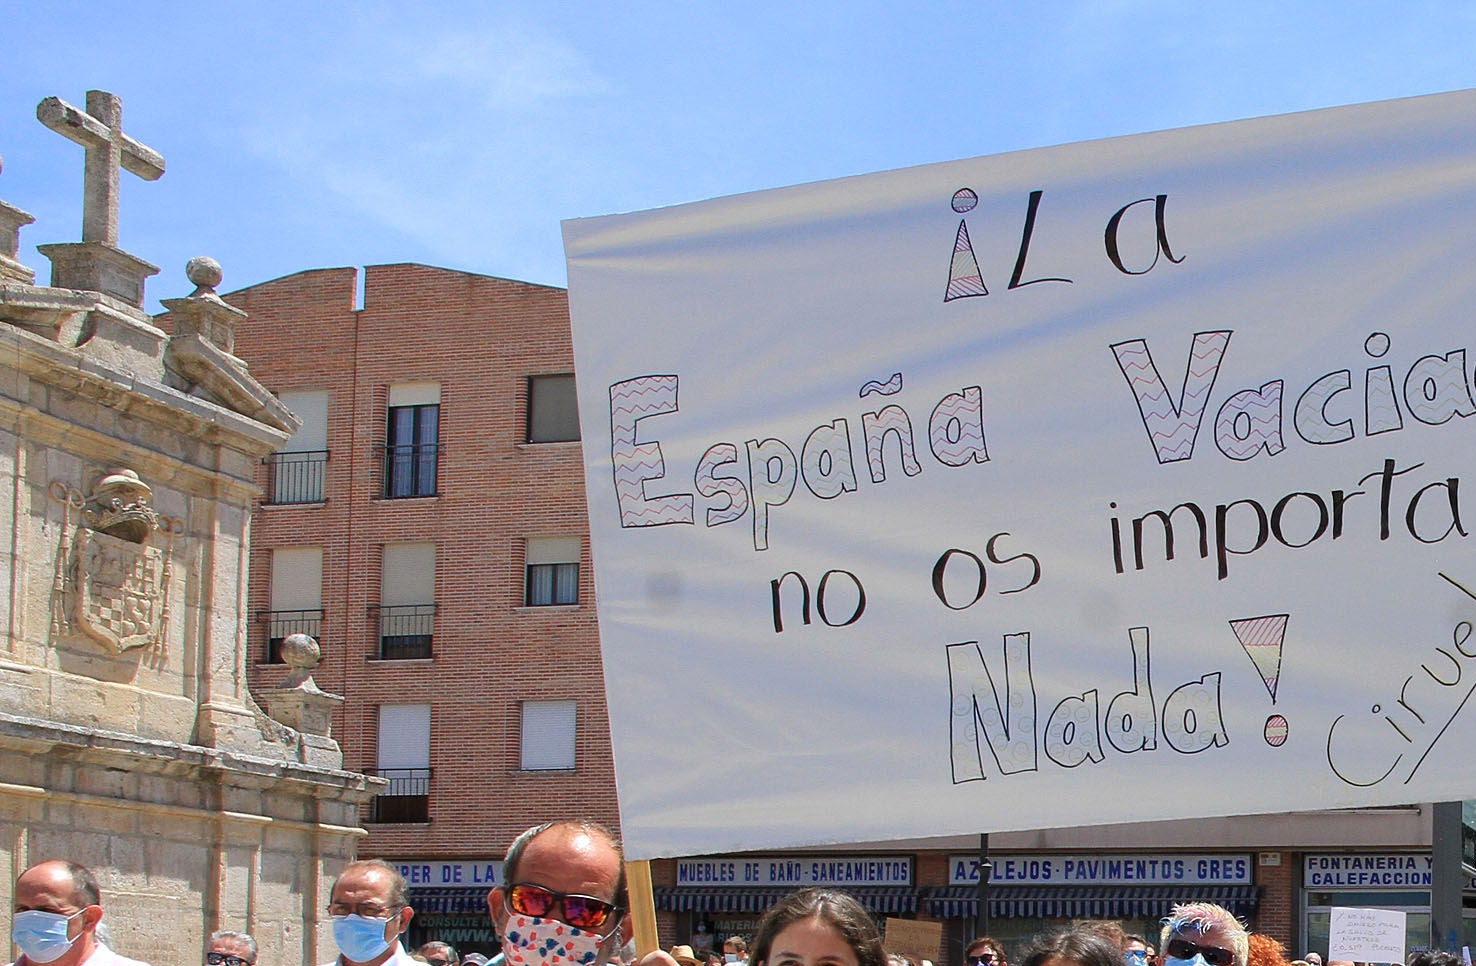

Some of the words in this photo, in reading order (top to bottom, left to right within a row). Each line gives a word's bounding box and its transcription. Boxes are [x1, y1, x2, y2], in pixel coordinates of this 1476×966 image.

[609, 373, 990, 550] España
[770, 569, 866, 632] no
[932, 532, 1041, 610] os
[1110, 459, 1468, 580] importa
[946, 614, 1289, 784] Nada!
[679, 863, 735, 882] MUEBLES
[745, 863, 759, 881] DE
[955, 860, 1051, 880] AZLEJOS
[1064, 860, 1184, 879] PAVIMENTOS
[1197, 859, 1245, 879] GRES
[1308, 857, 1416, 870] FONTANERIA
[1424, 857, 1433, 869] Y
[395, 865, 430, 883] PER
[442, 865, 462, 883] DE
[473, 865, 495, 883] LA
[1312, 873, 1432, 885] CALEFACCION
